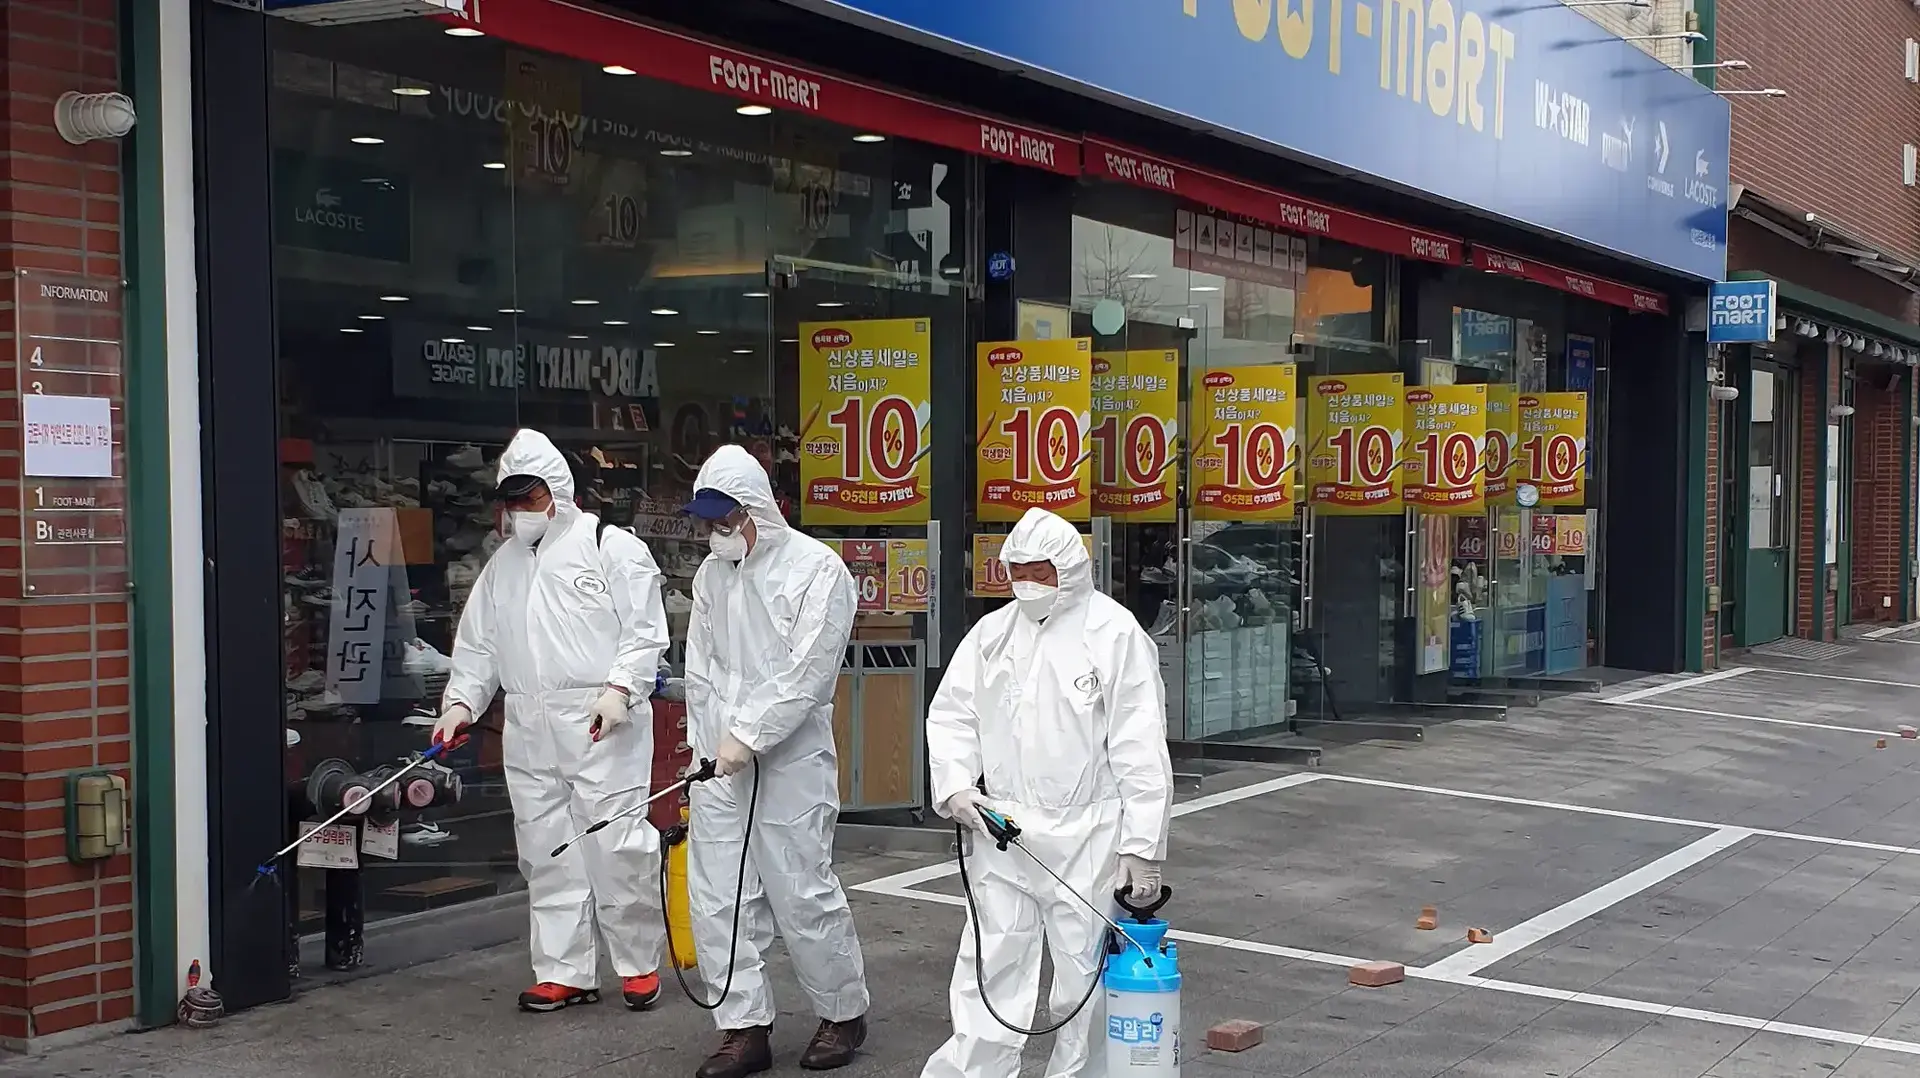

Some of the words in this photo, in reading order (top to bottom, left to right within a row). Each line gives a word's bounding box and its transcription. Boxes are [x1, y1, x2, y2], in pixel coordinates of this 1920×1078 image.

[1684, 177, 1718, 208] LACOSTE
[295, 207, 365, 232] LACOSTE
[40, 284, 108, 303] INFORMATION
[1712, 294, 1766, 310] FOOT
[30, 346, 43, 367] 4
[828, 372, 887, 393] 처음이지?
[1001, 387, 1054, 404] 처음이지?
[35, 486, 43, 506] 1
[36, 520, 53, 540] B1
